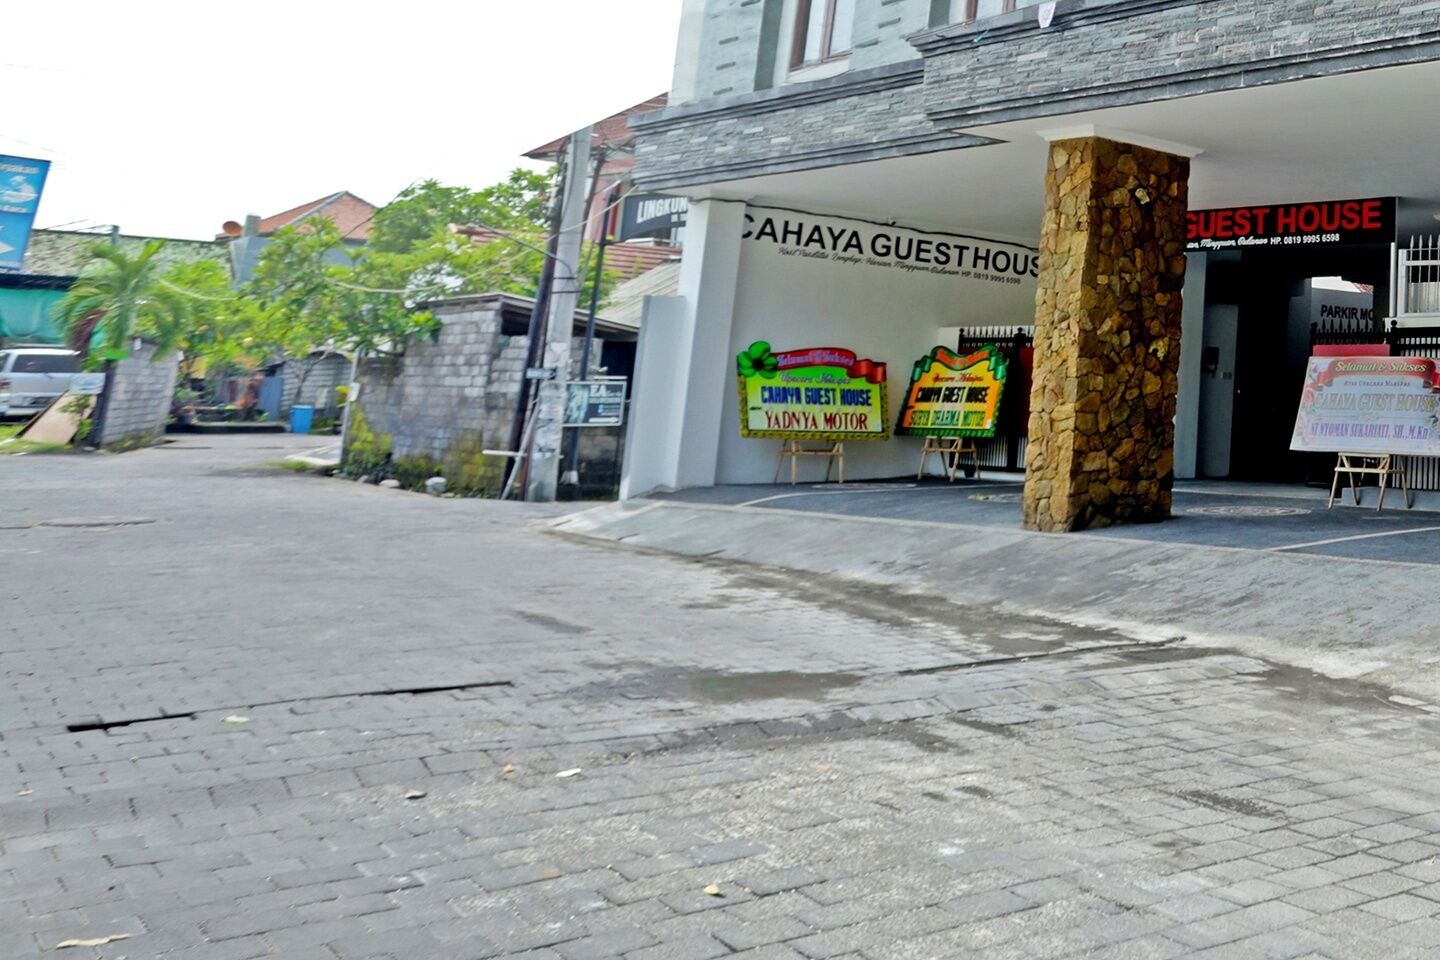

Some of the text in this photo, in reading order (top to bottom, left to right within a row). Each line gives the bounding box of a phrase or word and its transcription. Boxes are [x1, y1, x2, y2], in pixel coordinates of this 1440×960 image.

[1185, 200, 1382, 239] GUEST HOUSE
[742, 212, 865, 255] CAHAYA
[870, 232, 970, 268] GUEST
[1283, 235, 1301, 244] 0819
[1302, 234, 1321, 244] 9995
[1321, 233, 1340, 243] 6598
[1320, 304, 1359, 320] PARKIR
[1335, 361, 1427, 373] Selamat & Sukses
[804, 387, 836, 406] GUEST
[839, 388, 872, 406] HOUSE
[1315, 393, 1438, 413] CAHAYA GUEST HOUSE
[764, 410, 868, 430] YADNYA MOTOR
